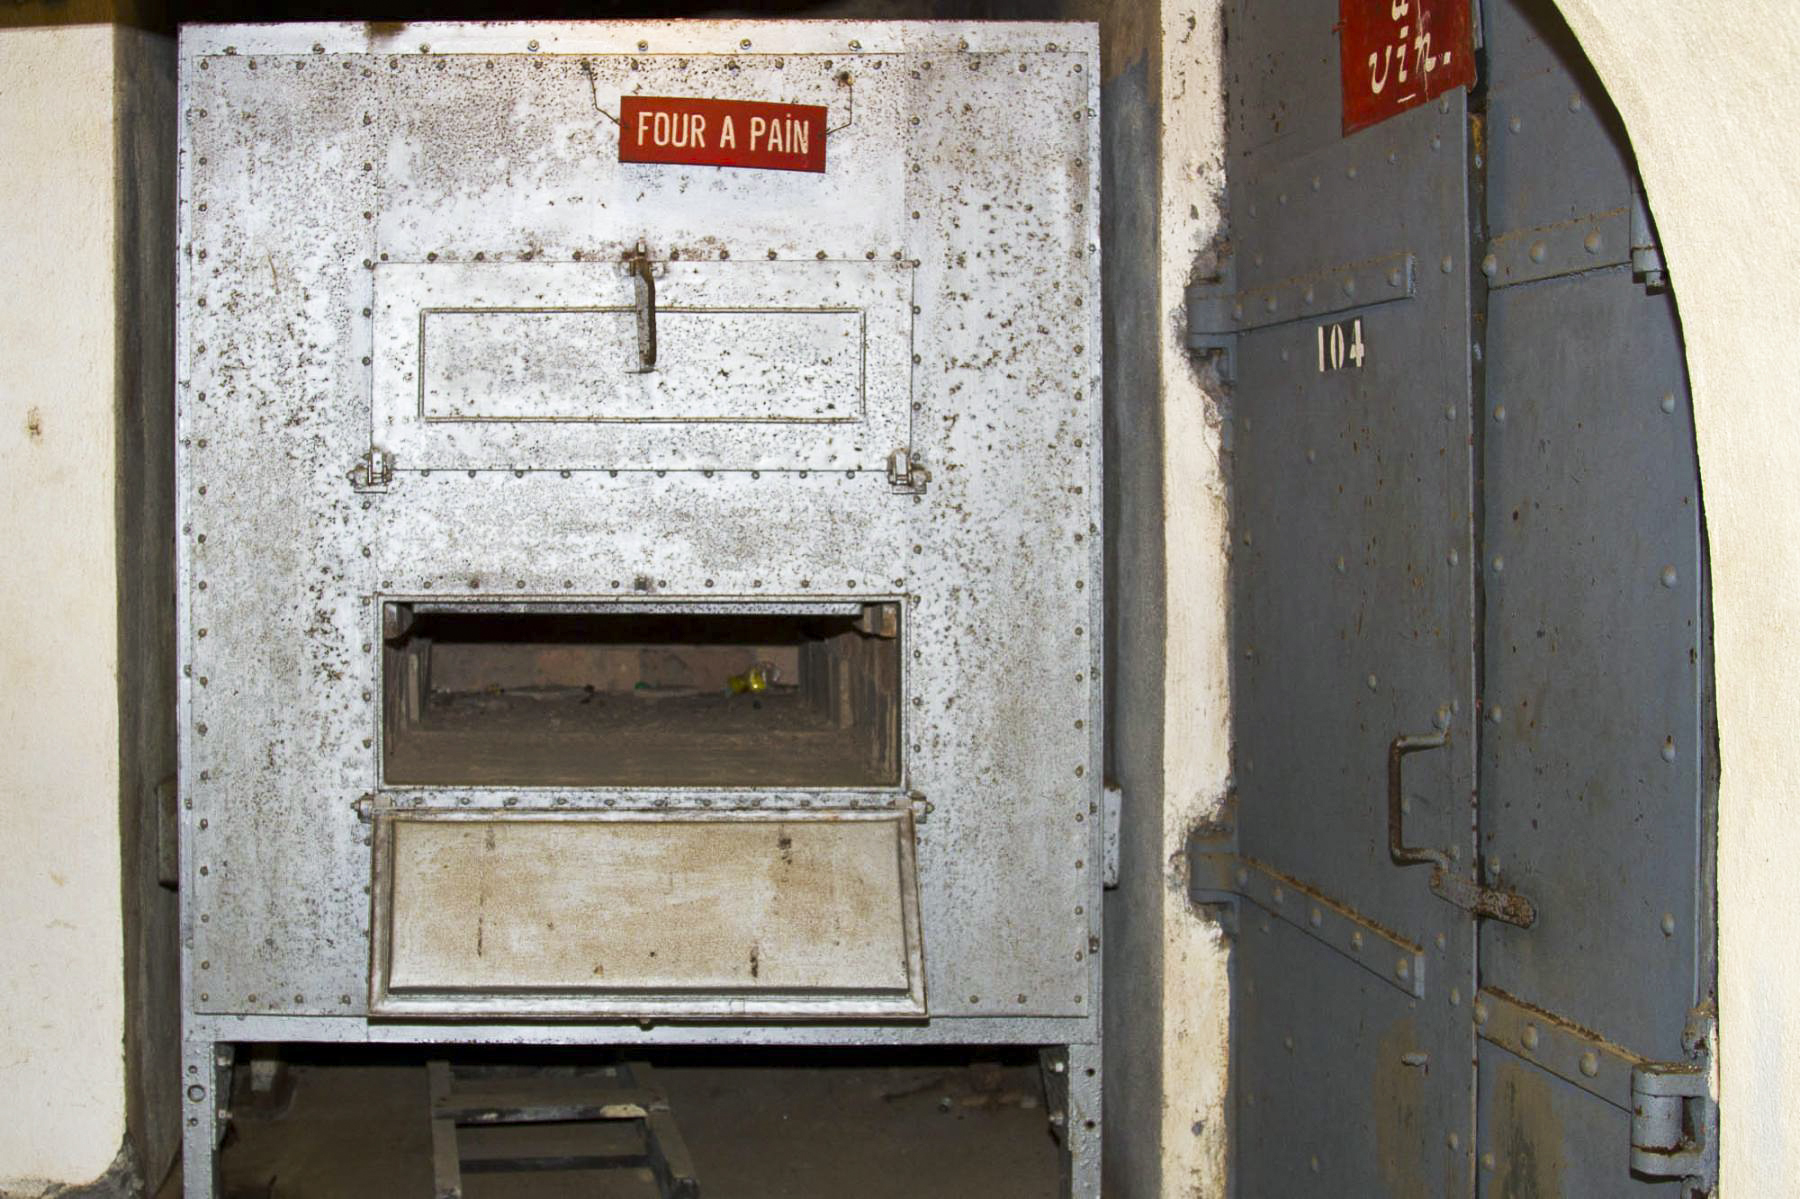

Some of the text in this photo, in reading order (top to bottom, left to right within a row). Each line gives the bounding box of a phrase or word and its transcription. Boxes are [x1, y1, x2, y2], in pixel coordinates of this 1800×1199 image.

[637, 111, 706, 148] FOUR
[719, 115, 736, 149] A
[1317, 319, 1365, 372] 104
